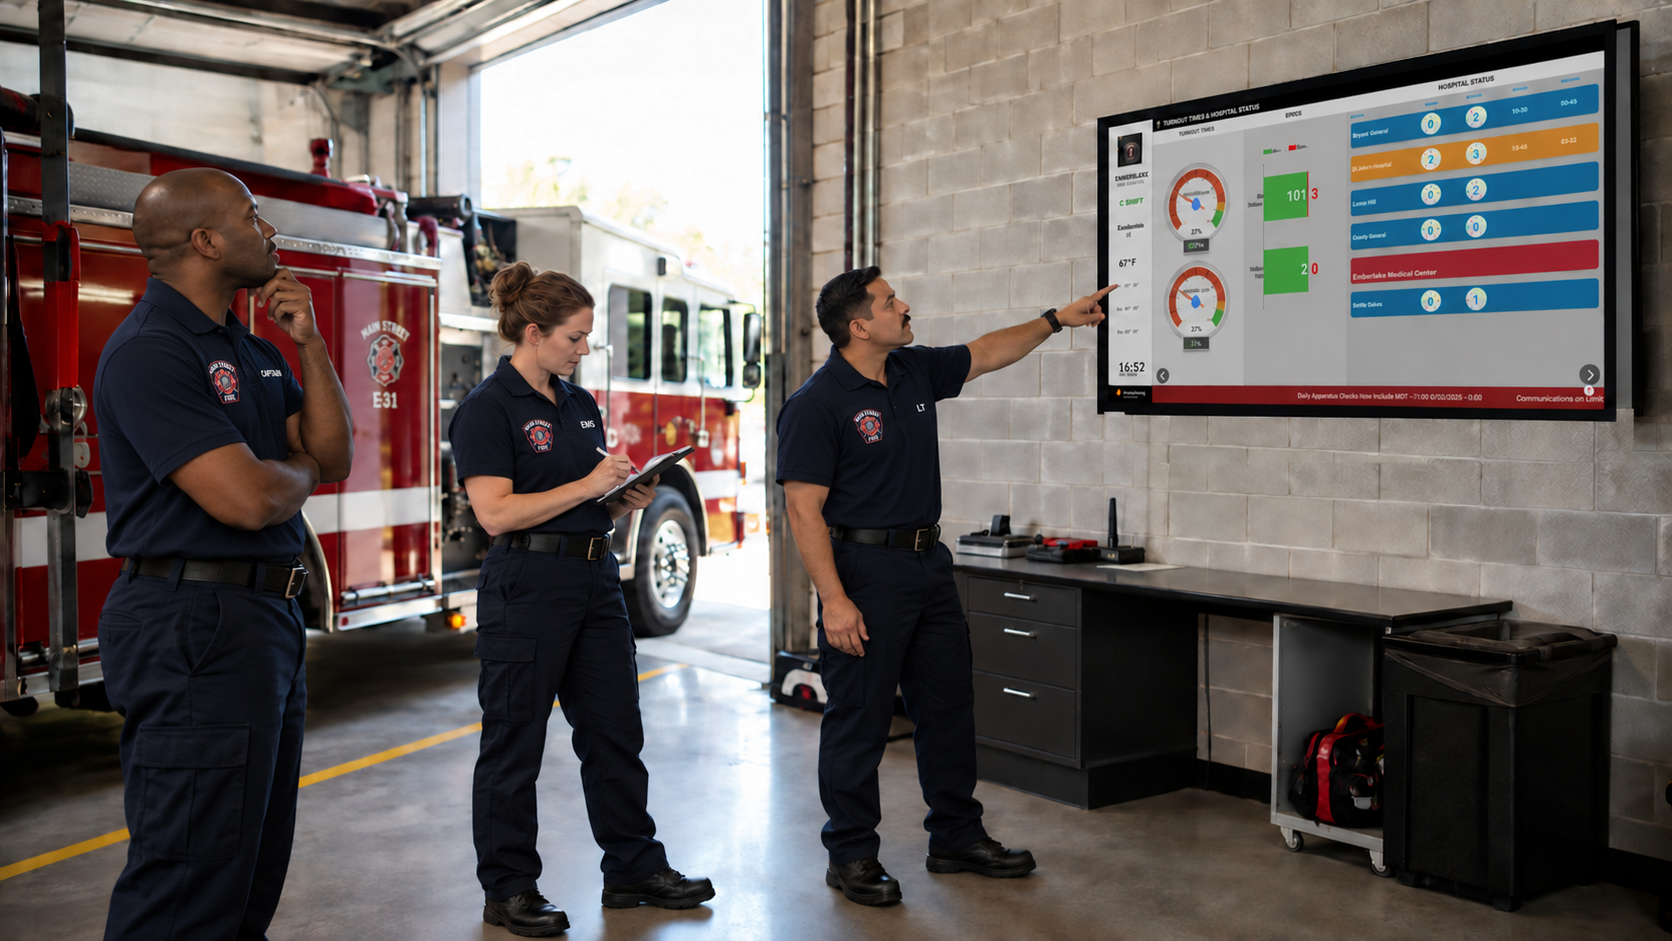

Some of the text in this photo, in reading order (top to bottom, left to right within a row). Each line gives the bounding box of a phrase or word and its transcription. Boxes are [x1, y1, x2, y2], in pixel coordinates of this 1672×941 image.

[1438, 75, 1495, 91] HOSPITAL STATUS
[1163, 116, 1188, 127] TURNOUT
[1210, 107, 1238, 119] HOSPITAL
[1238, 103, 1260, 113] STATUS
[1427, 119, 1434, 129] 0
[1472, 112, 1480, 122] 2
[1428, 154, 1434, 164] 2
[1472, 149, 1480, 159] 3
[1287, 187, 1319, 202] 101 3
[1427, 190, 1434, 200] 0
[1472, 185, 1480, 196] 2
[1119, 199, 1125, 207] C
[1427, 225, 1434, 236] 0
[1472, 221, 1479, 232] 0
[1301, 262, 1319, 275] 2 0
[1427, 296, 1434, 307] 0
[1472, 294, 1479, 305] 1
[361, 320, 410, 342] MAIN STREET
[1118, 361, 1146, 373] 16:52
[372, 391, 398, 409] E31
[1516, 394, 1574, 403] Communications
[916, 403, 926, 413] LT
[580, 419, 596, 429] EMS
